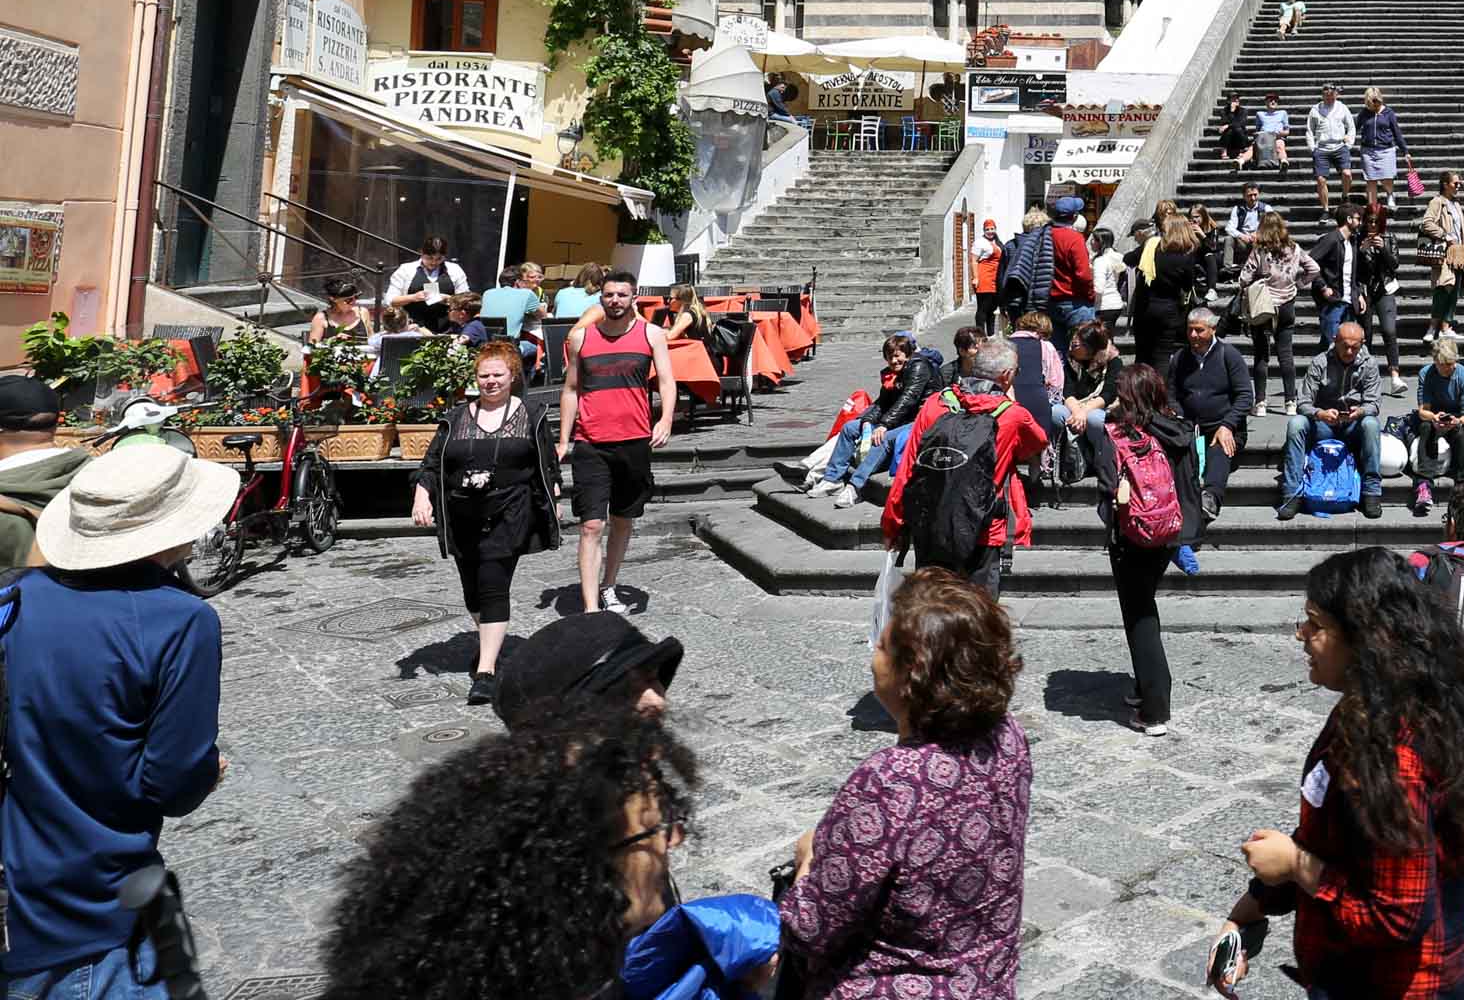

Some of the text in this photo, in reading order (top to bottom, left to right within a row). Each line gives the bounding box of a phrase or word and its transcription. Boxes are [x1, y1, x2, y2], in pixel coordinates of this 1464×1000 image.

[317, 10, 365, 46] RISTORANTE
[323, 36, 358, 64] PIZZERIA
[329, 61, 360, 85] ANDREA
[427, 60, 449, 70] dal
[374, 71, 537, 99] RISTORANTE
[394, 90, 515, 111] PIZZERIA
[818, 94, 904, 108] RISTORANTE
[418, 107, 525, 131] ANDREA
[1064, 113, 1105, 122] PANINI
[1108, 113, 1116, 122] E
